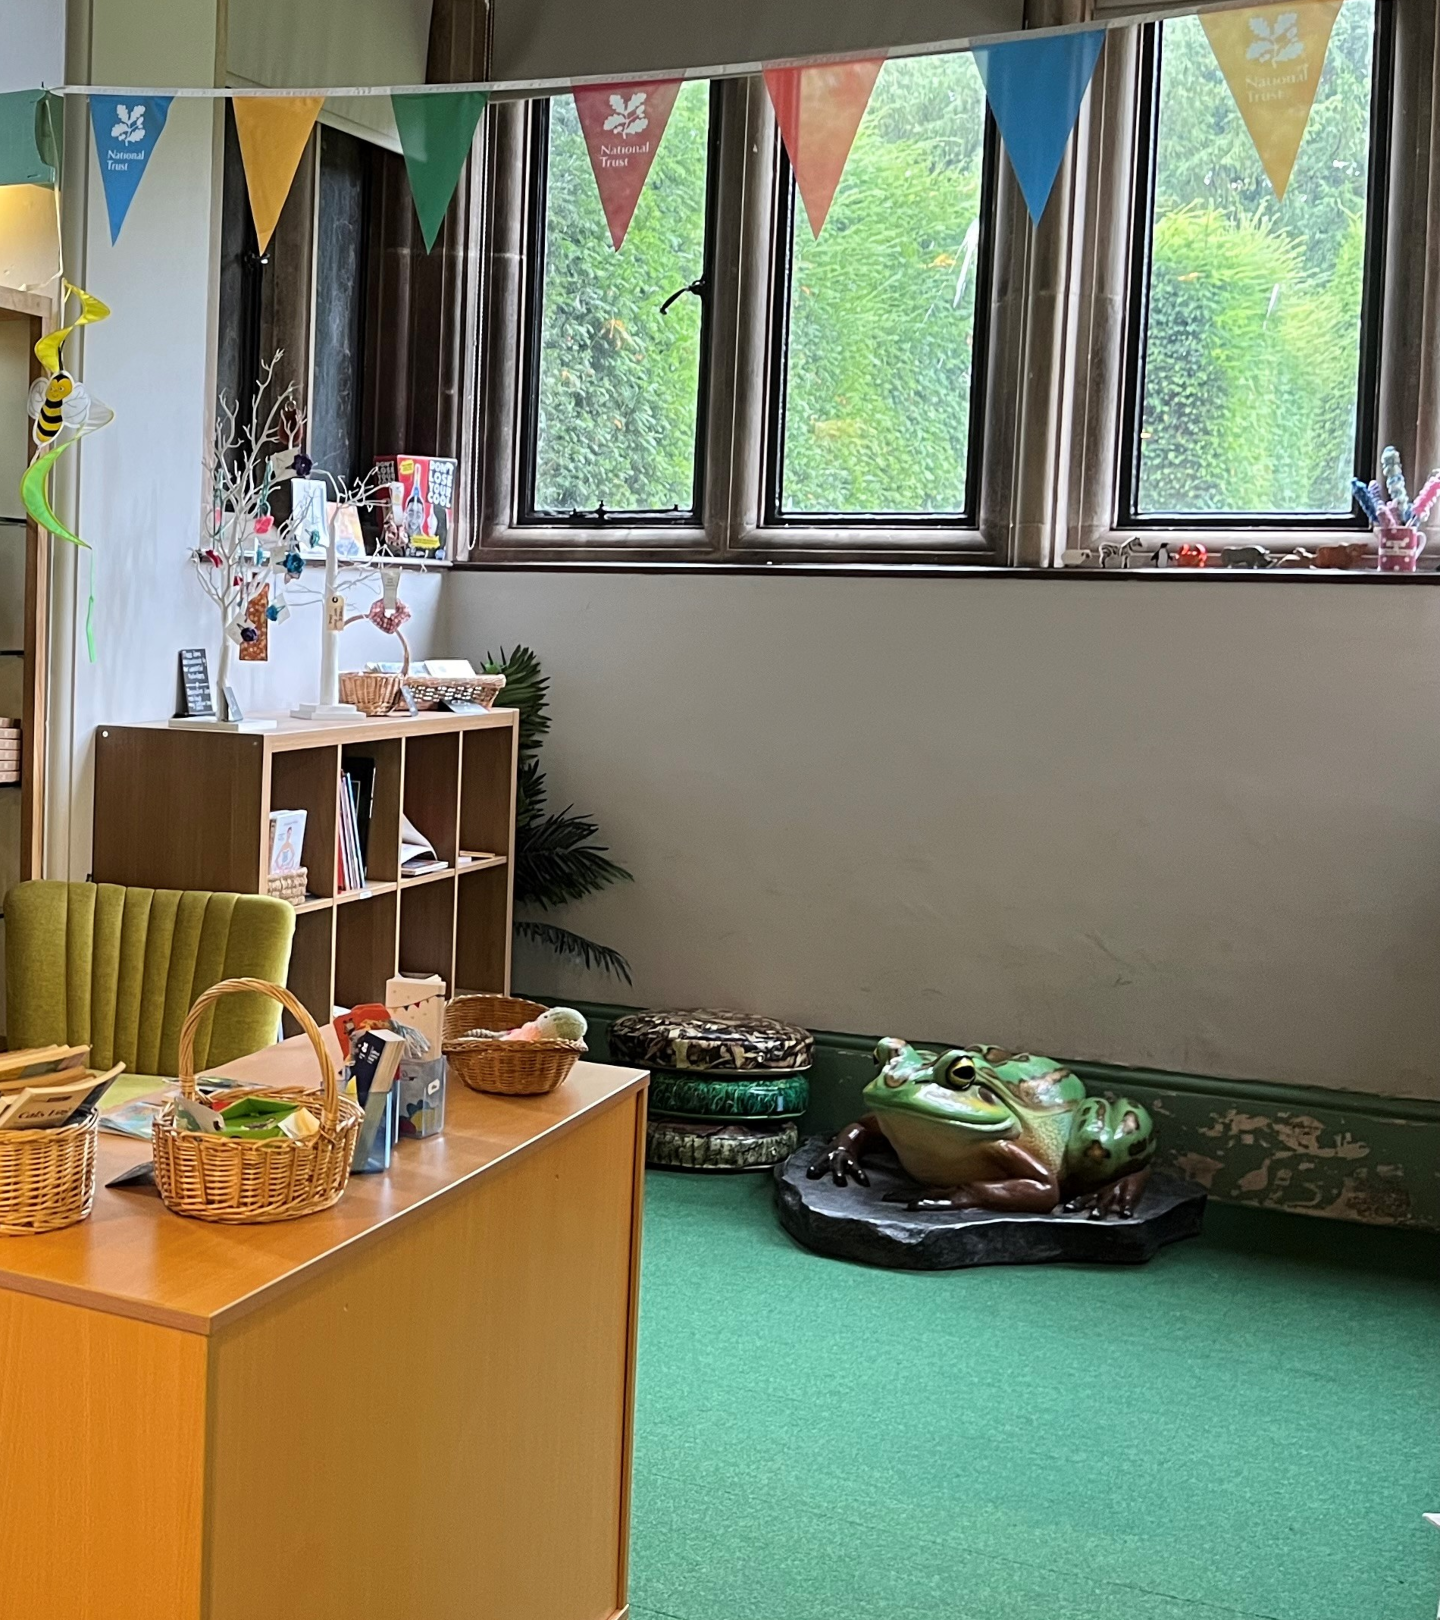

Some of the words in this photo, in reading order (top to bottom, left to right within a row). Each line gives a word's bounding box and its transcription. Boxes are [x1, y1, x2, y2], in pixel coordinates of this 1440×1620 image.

[107, 149, 145, 160] National
[600, 141, 650, 155] National
[106, 160, 128, 171] Trust
[599, 156, 628, 168] Trust
[430, 460, 454, 475] DON'T
[429, 471, 453, 487] LOSE
[429, 482, 452, 496] YOUR
[428, 492, 451, 508] COOL
